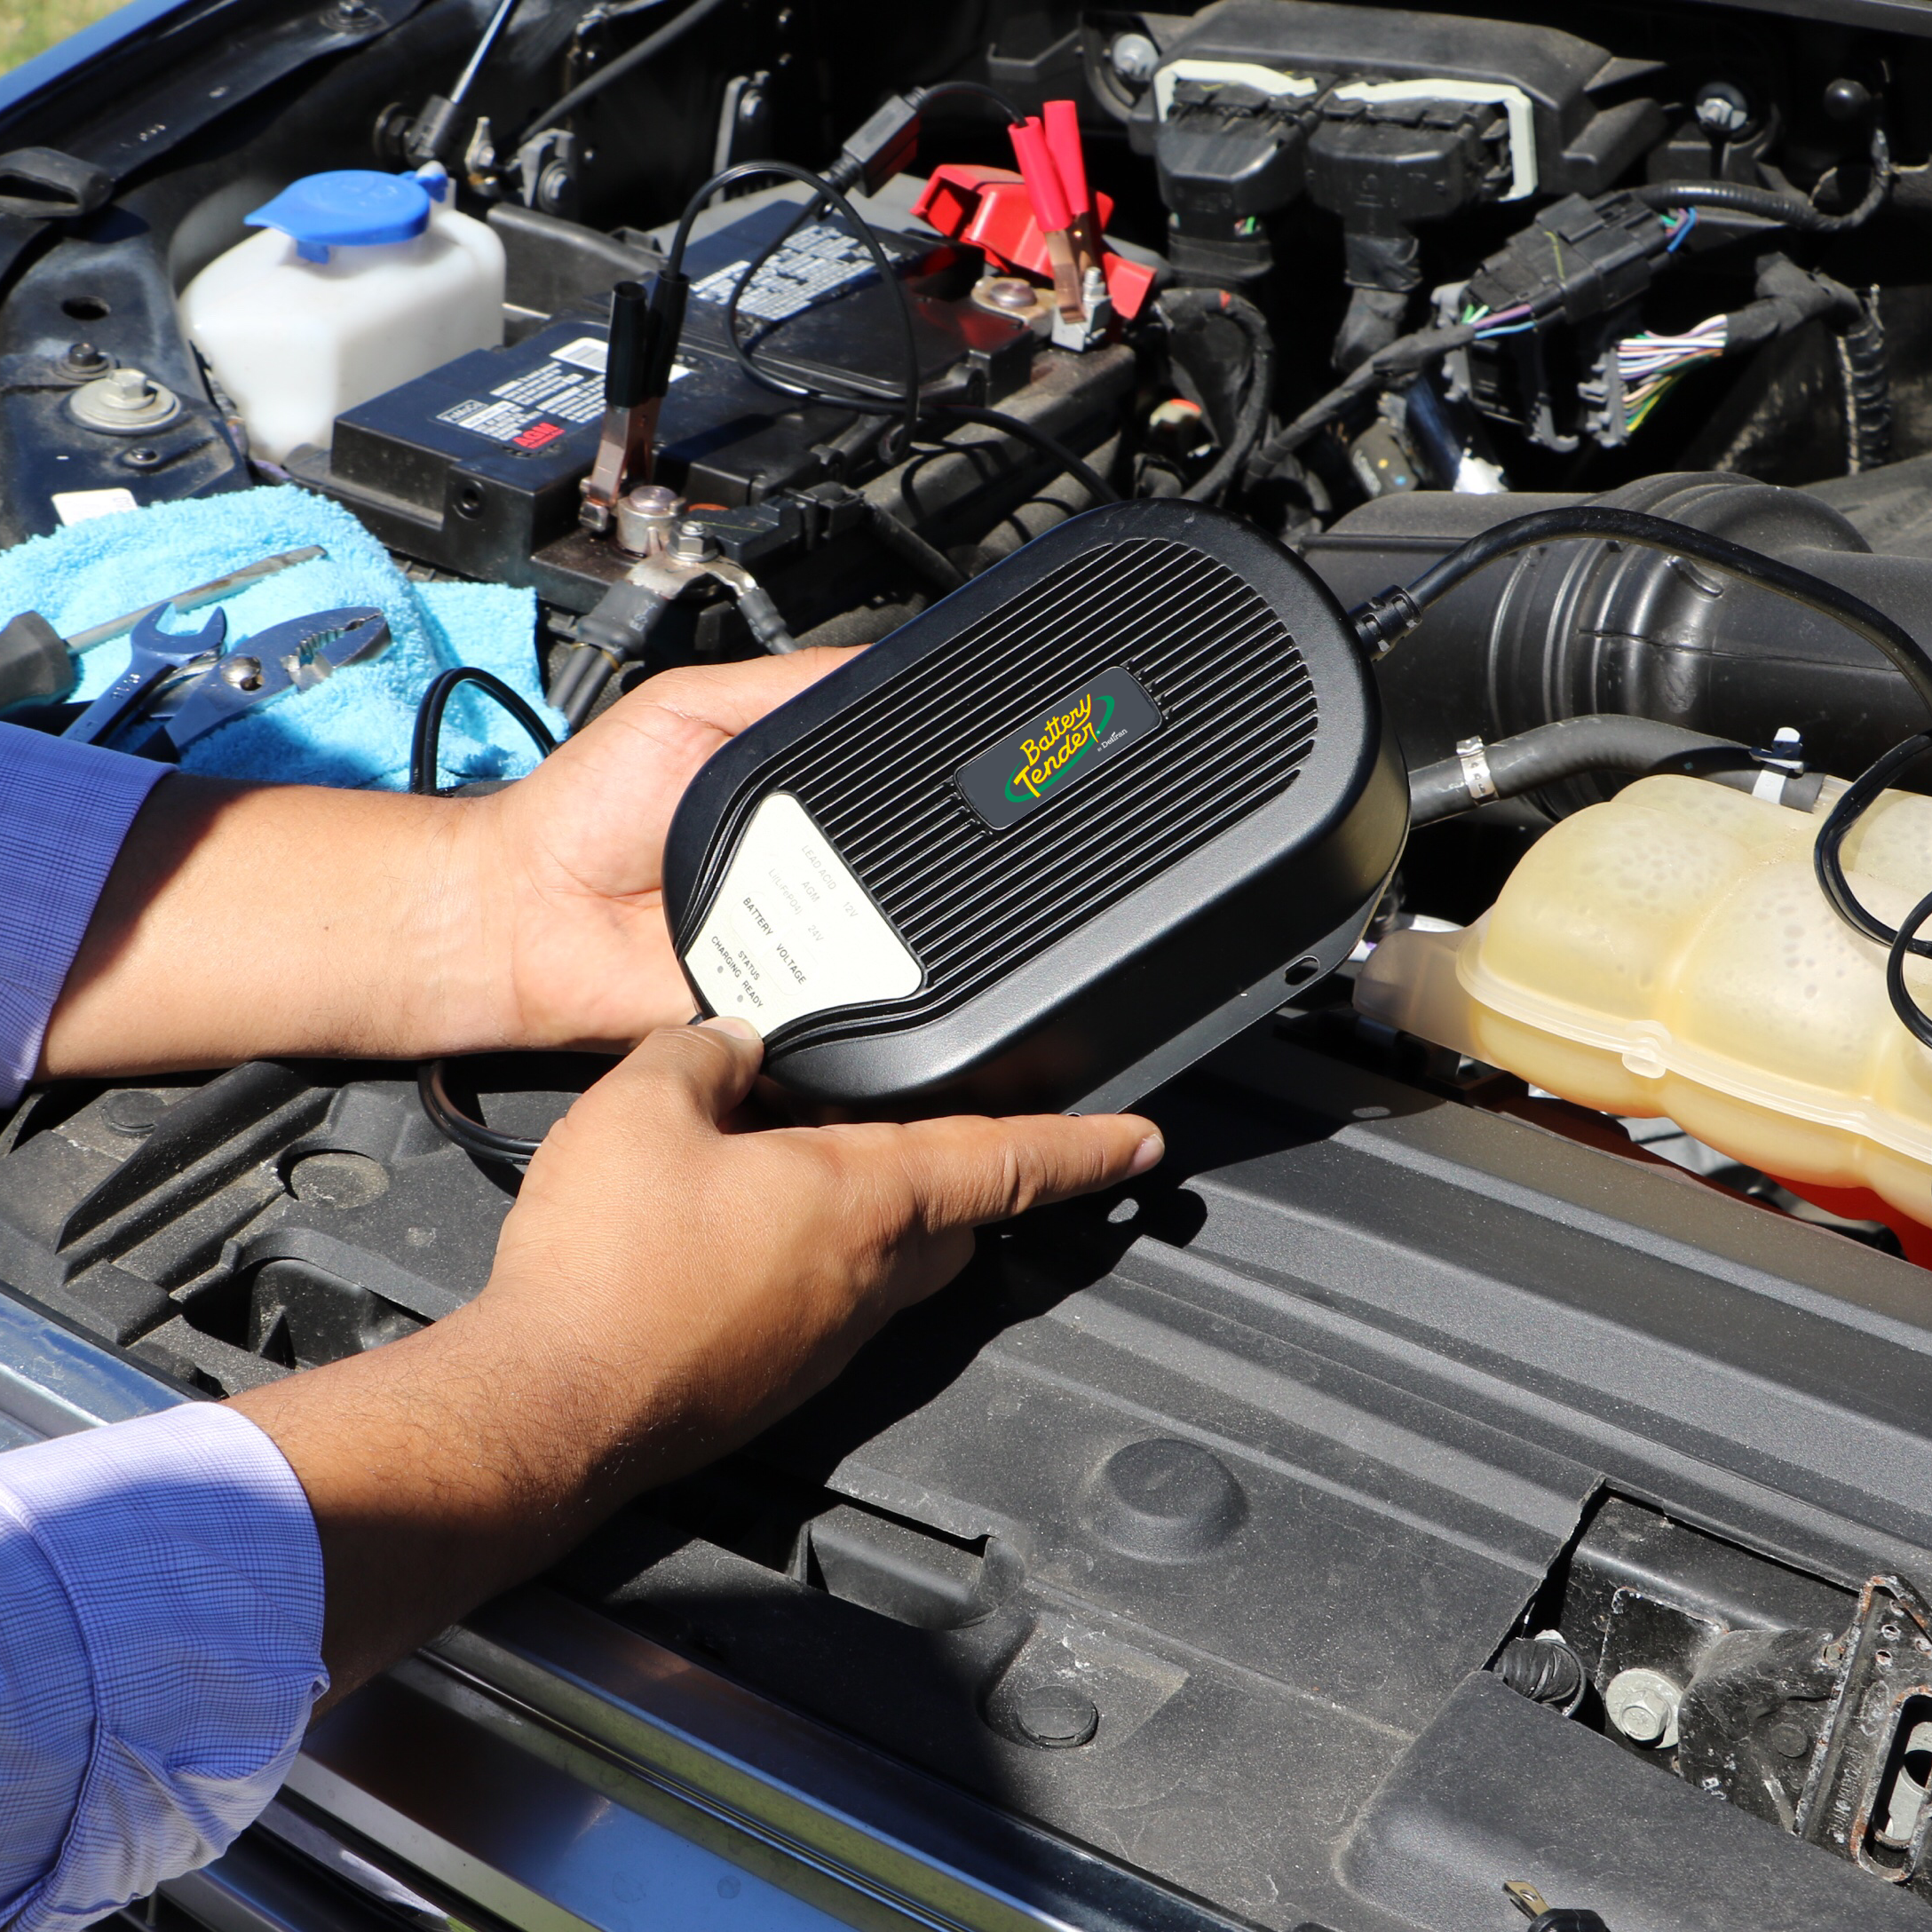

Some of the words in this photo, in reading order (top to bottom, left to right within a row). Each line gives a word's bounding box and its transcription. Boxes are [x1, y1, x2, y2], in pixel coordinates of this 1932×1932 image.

[513, 423, 559, 447] AGM
[1020, 693, 1092, 766] Battery
[1101, 729, 1128, 748] Deltran
[1013, 722, 1099, 798] Tender
[801, 844, 821, 868] LEAD
[819, 869, 837, 891] ACID
[801, 881, 820, 903] AGM
[742, 897, 773, 936] BATTERY
[843, 901, 859, 918] 12V
[807, 924, 824, 942] 24V
[710, 936, 742, 978] CHARGING
[738, 950, 761, 980] STATUS
[775, 943, 807, 985] VOLTAGE
[741, 980, 764, 1009] READY
